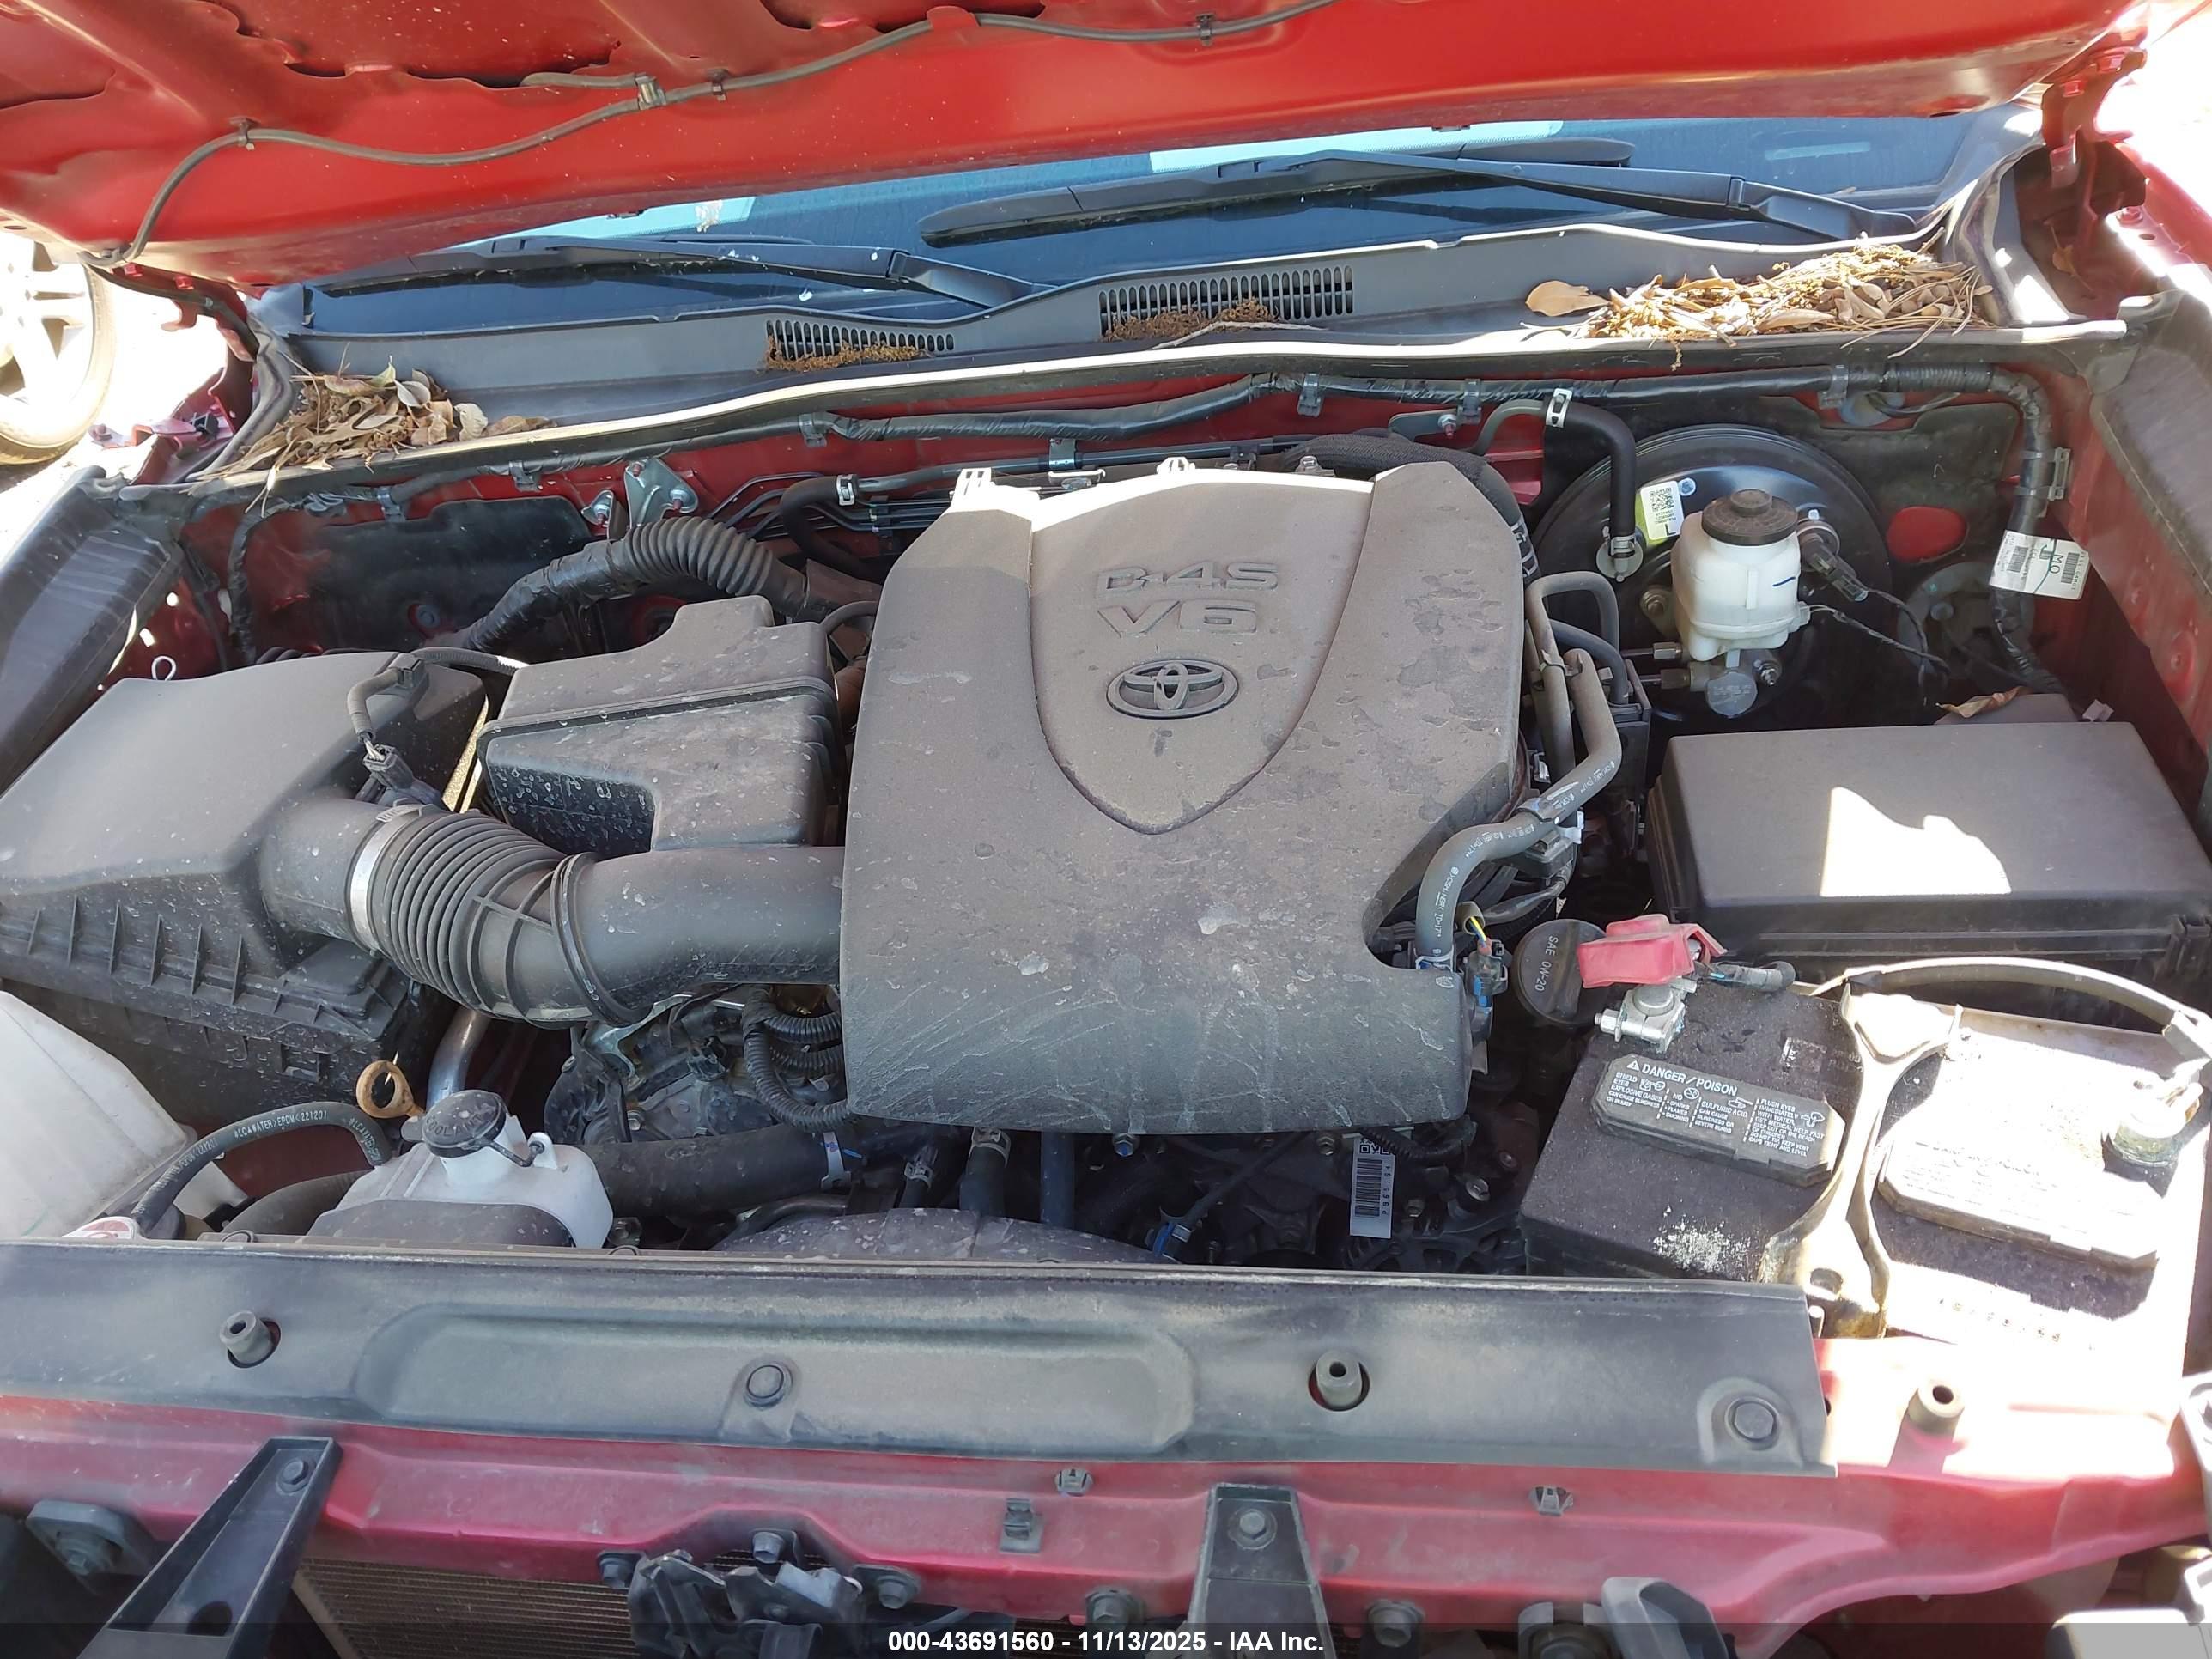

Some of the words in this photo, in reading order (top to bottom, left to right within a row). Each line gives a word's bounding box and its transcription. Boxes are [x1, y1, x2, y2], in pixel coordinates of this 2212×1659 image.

[1097, 599, 1258, 638] V6
[1545, 935, 1559, 957] SAE
[1615, 1072, 1638, 1083] SHIELD
[1611, 1084, 1643, 1097] EXPLOSIVE
[1732, 1109, 1748, 1118] ACID
